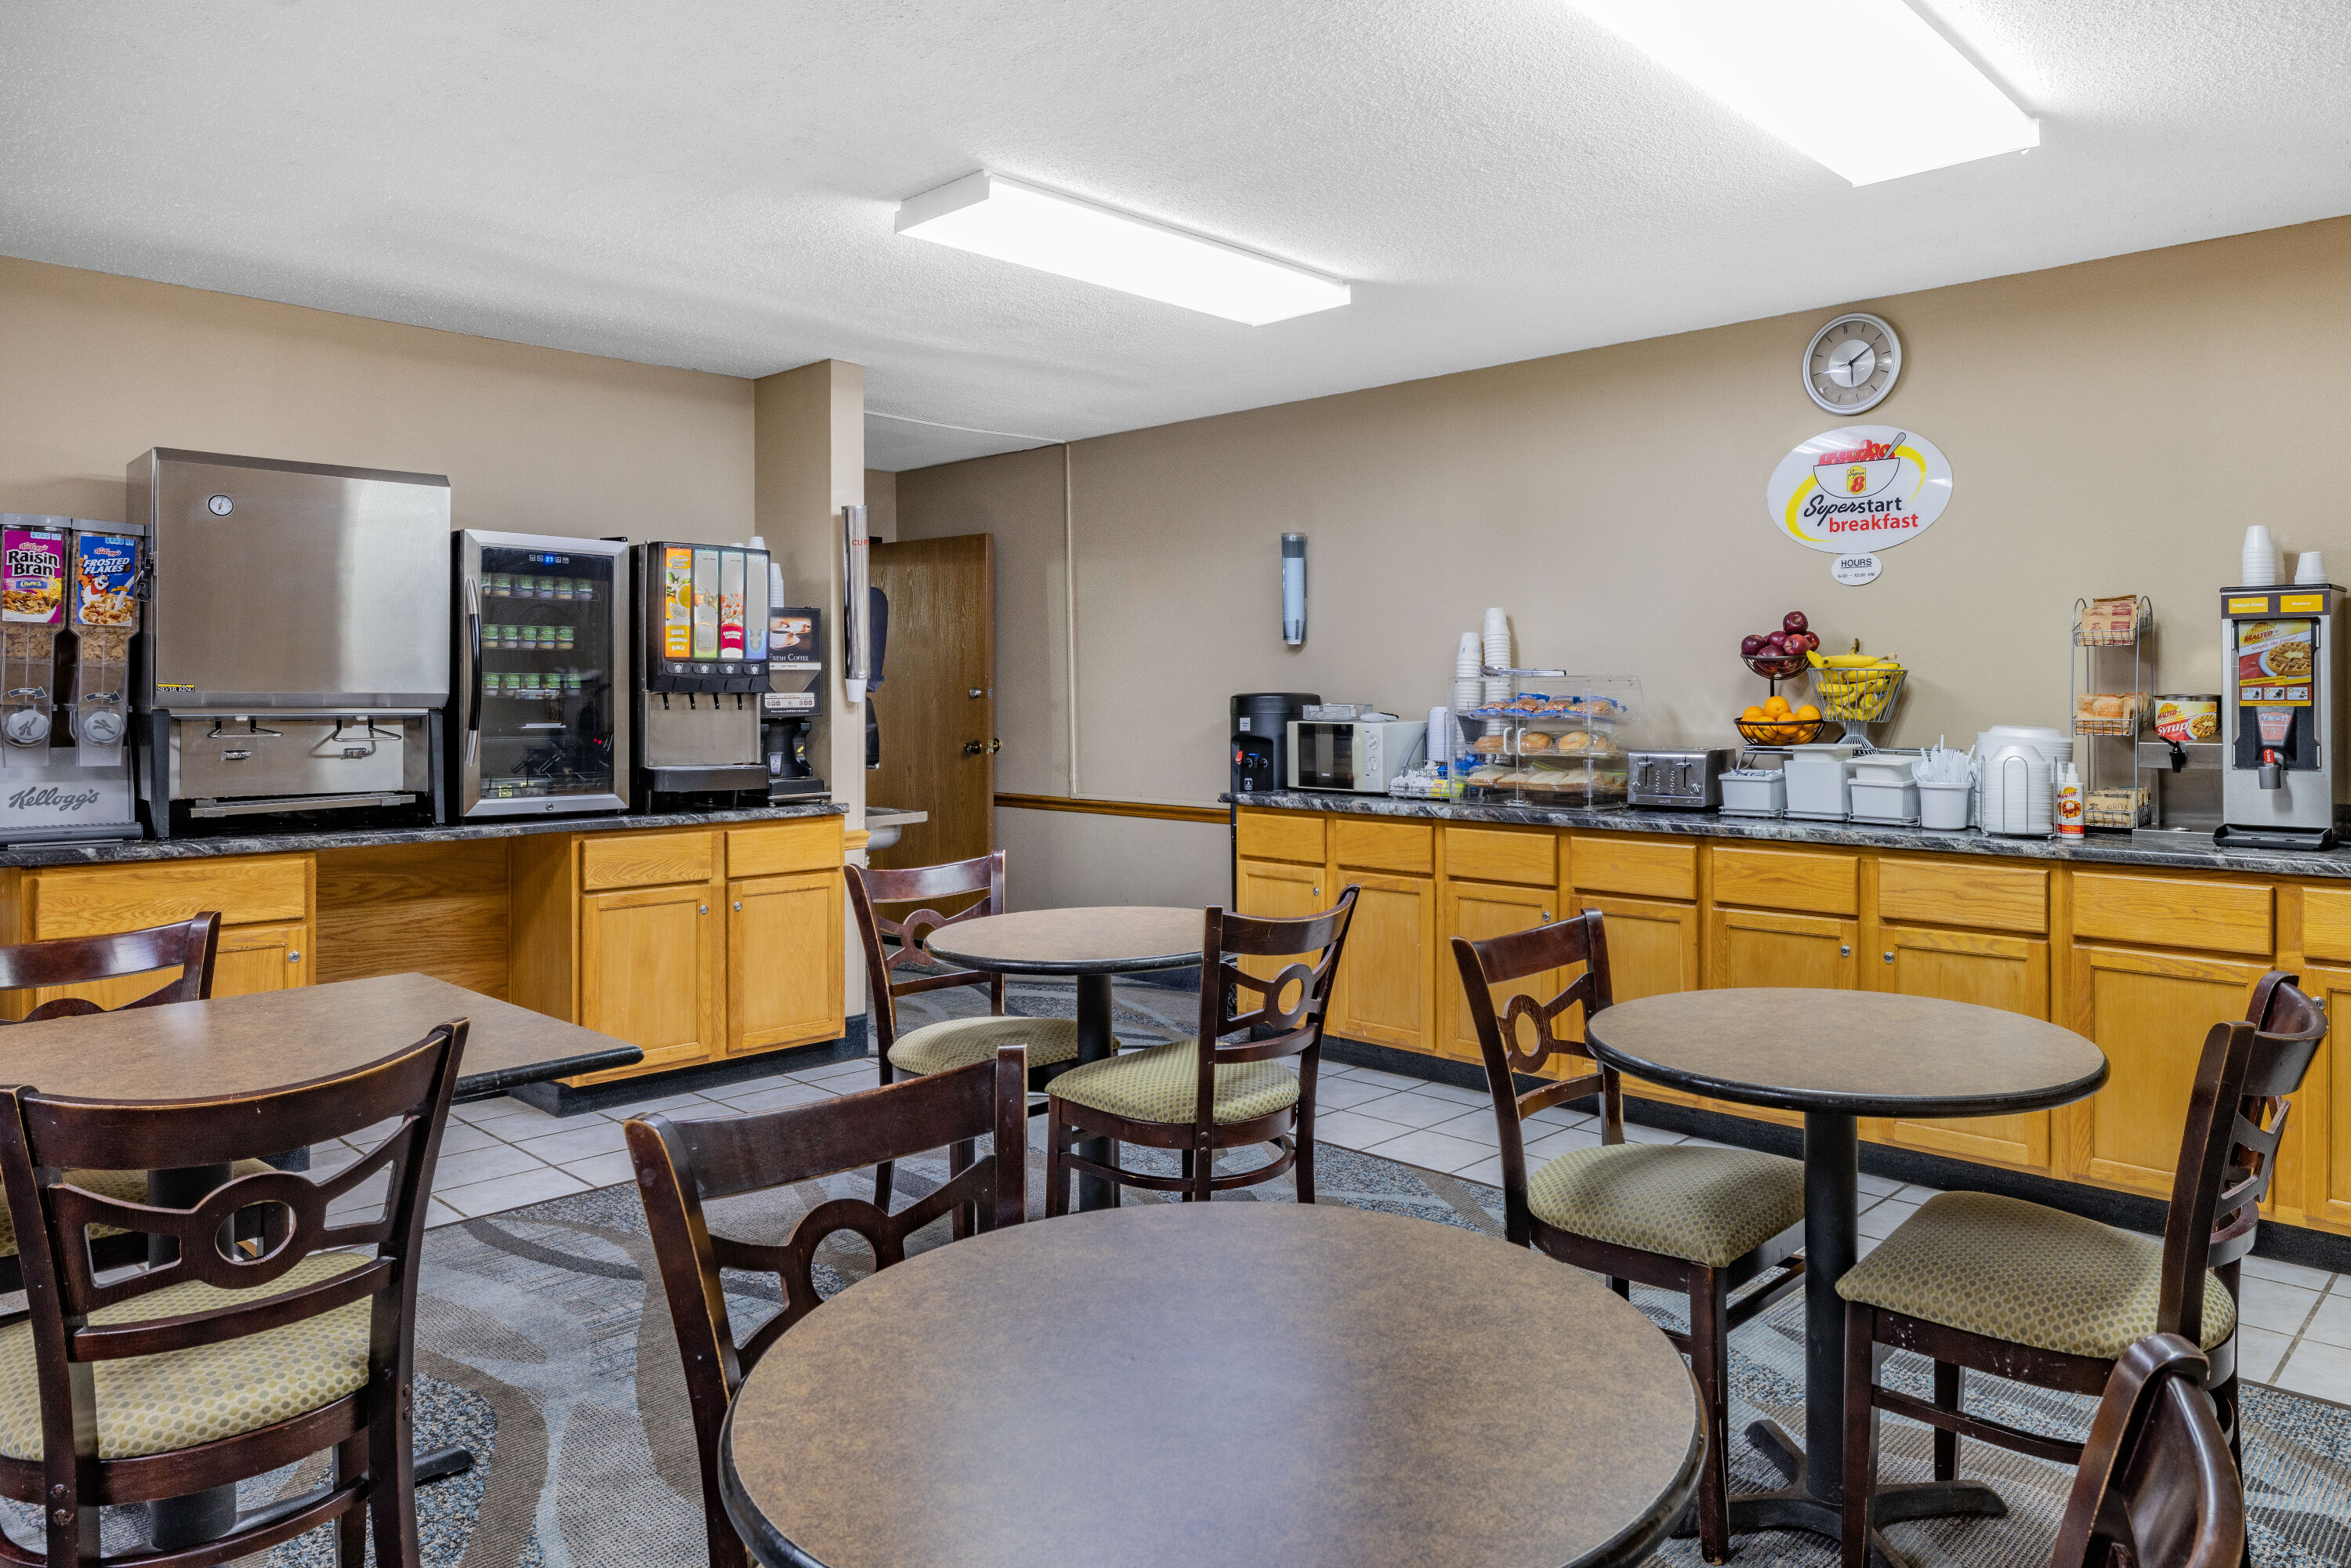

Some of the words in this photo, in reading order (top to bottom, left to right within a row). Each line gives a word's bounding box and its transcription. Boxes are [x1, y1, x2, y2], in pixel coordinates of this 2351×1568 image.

[1848, 469, 1864, 479] Super
[1850, 476, 1865, 492] 8
[1803, 494, 1903, 527] Superstart
[1829, 513, 1919, 533] breakfast
[7, 550, 59, 567] Raisin
[82, 557, 130, 567] FROSTED
[1841, 558, 1872, 567] HOURS
[13, 563, 53, 577] Bran
[83, 564, 125, 574] FLAKES
[2157, 722, 2189, 737] Syrup
[8, 786, 100, 811] Kellogg's
